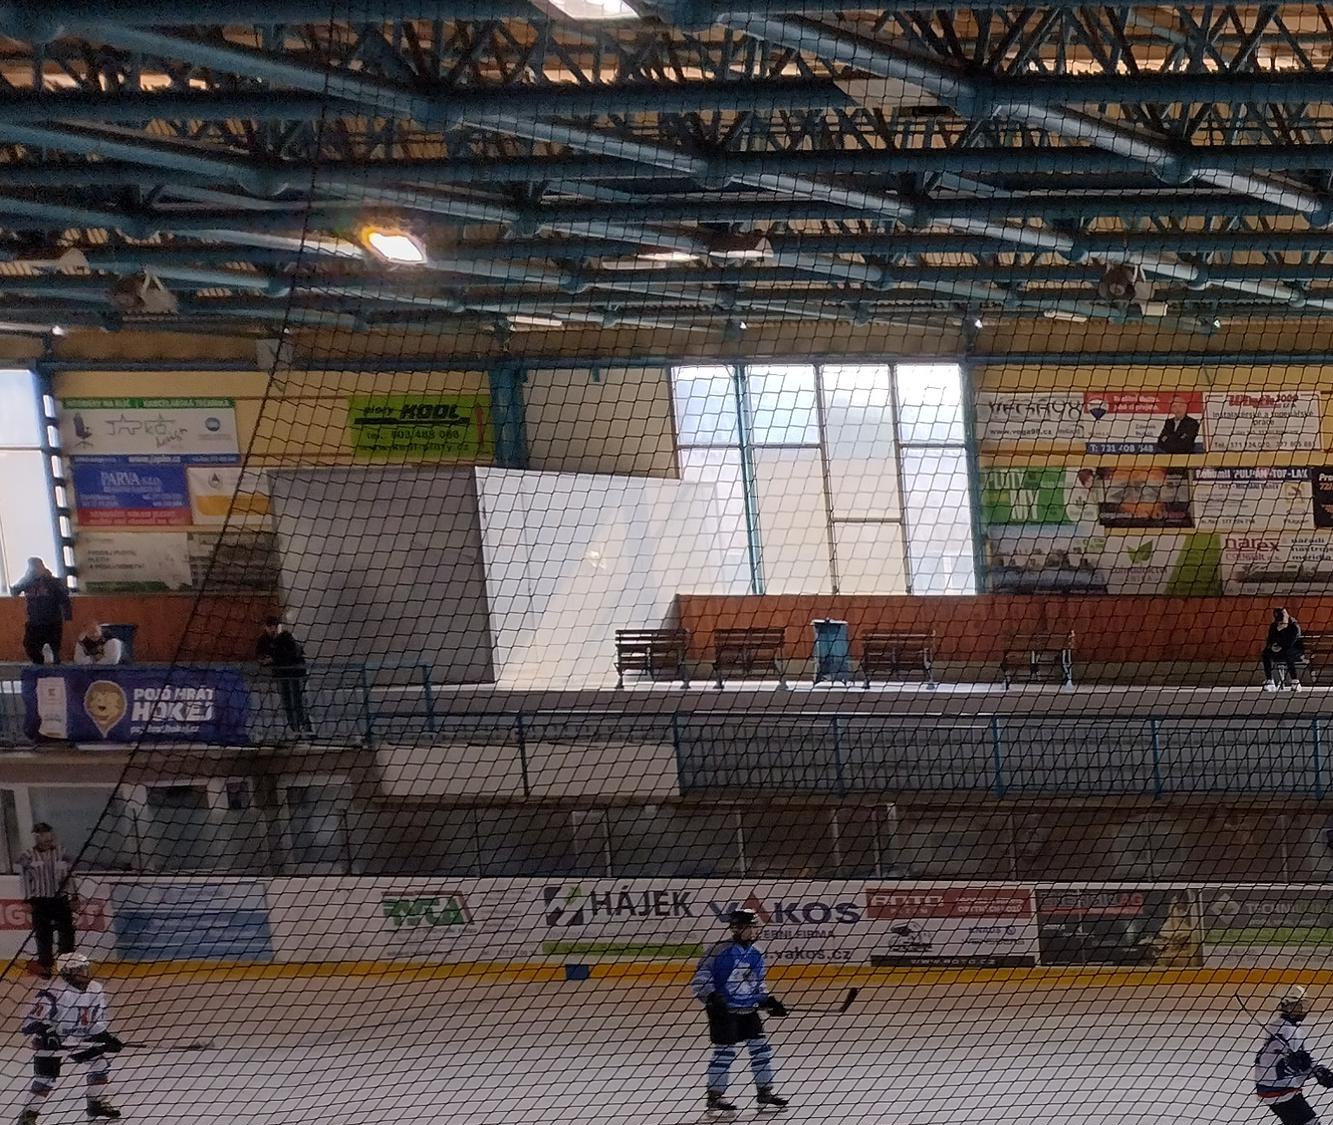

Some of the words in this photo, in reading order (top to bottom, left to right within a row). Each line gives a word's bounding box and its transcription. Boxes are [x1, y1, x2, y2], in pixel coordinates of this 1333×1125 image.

[1225, 538, 1280, 552] narex
[132, 701, 216, 721] HOKEJ
[591, 885, 694, 917] HÁJEK
